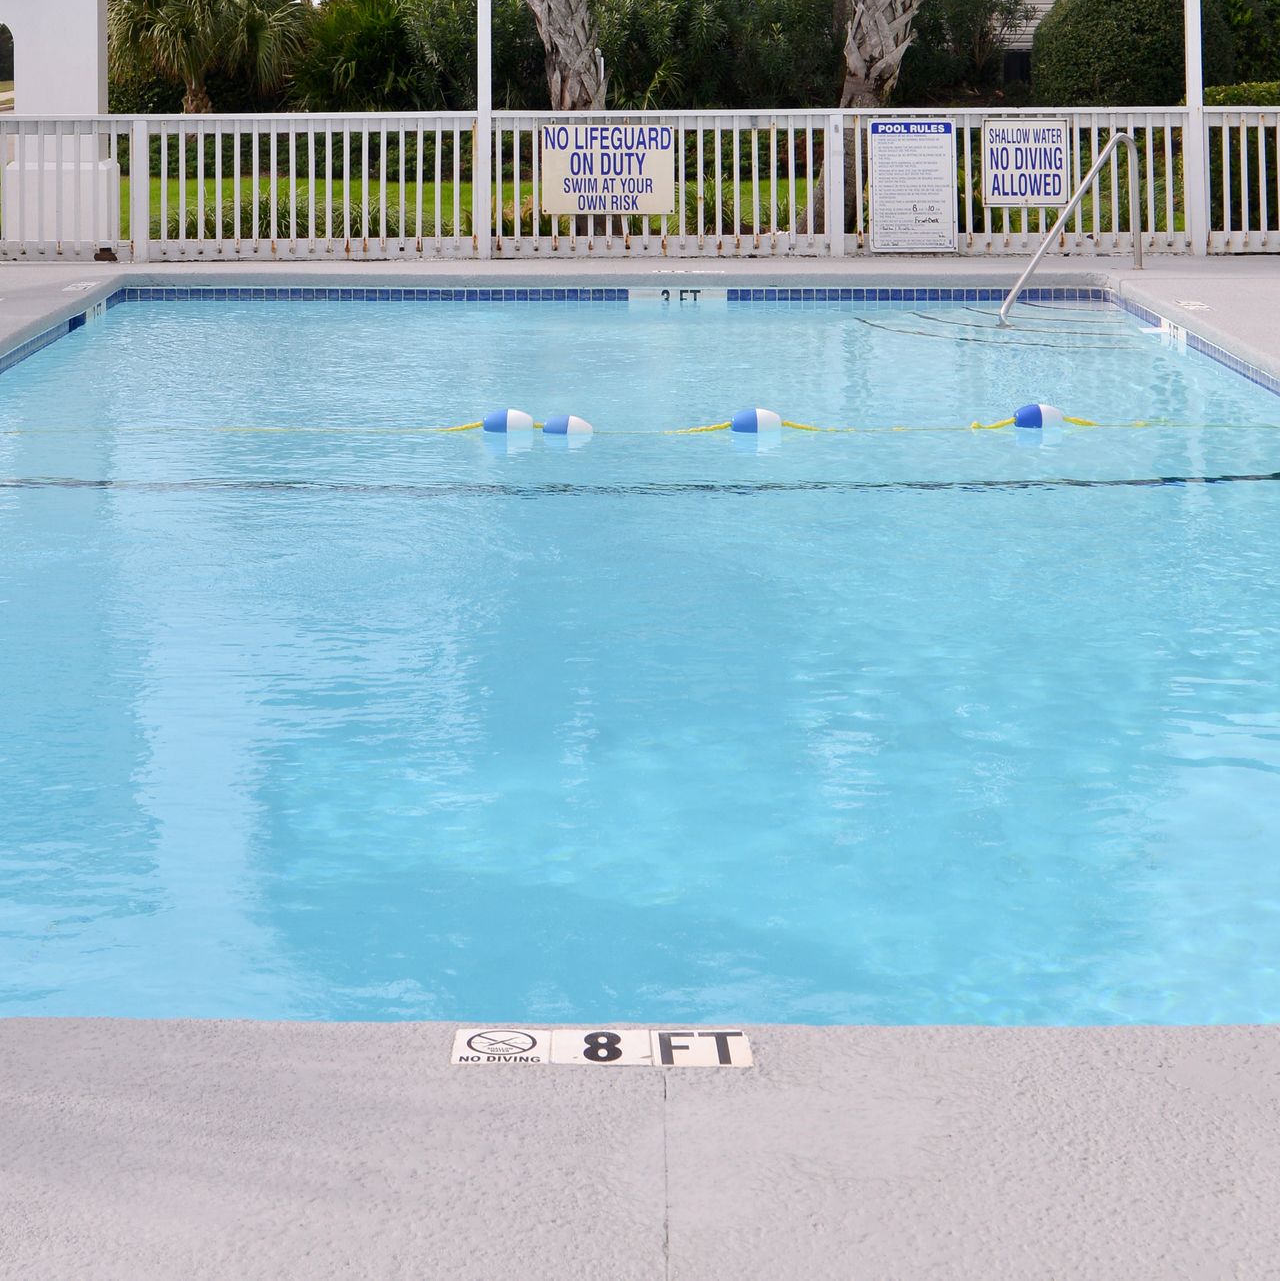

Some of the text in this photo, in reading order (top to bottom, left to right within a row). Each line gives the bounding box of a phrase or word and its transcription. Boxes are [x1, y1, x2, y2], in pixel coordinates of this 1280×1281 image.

[878, 124, 945, 133] POOL RULES
[989, 128, 1062, 144] SHALLOW WATER
[545, 127, 671, 150] NO LIFEGUARD
[570, 152, 646, 175] ON DUTY
[990, 147, 1063, 170] NO DIVING
[563, 178, 653, 193] SWIM AT YOUR
[991, 173, 1061, 196] ALLOWED
[578, 195, 639, 210] OWN RISK
[680, 290, 701, 301] FT
[583, 1031, 743, 1065] 8 FT
[459, 1055, 541, 1063] NO DIVING
